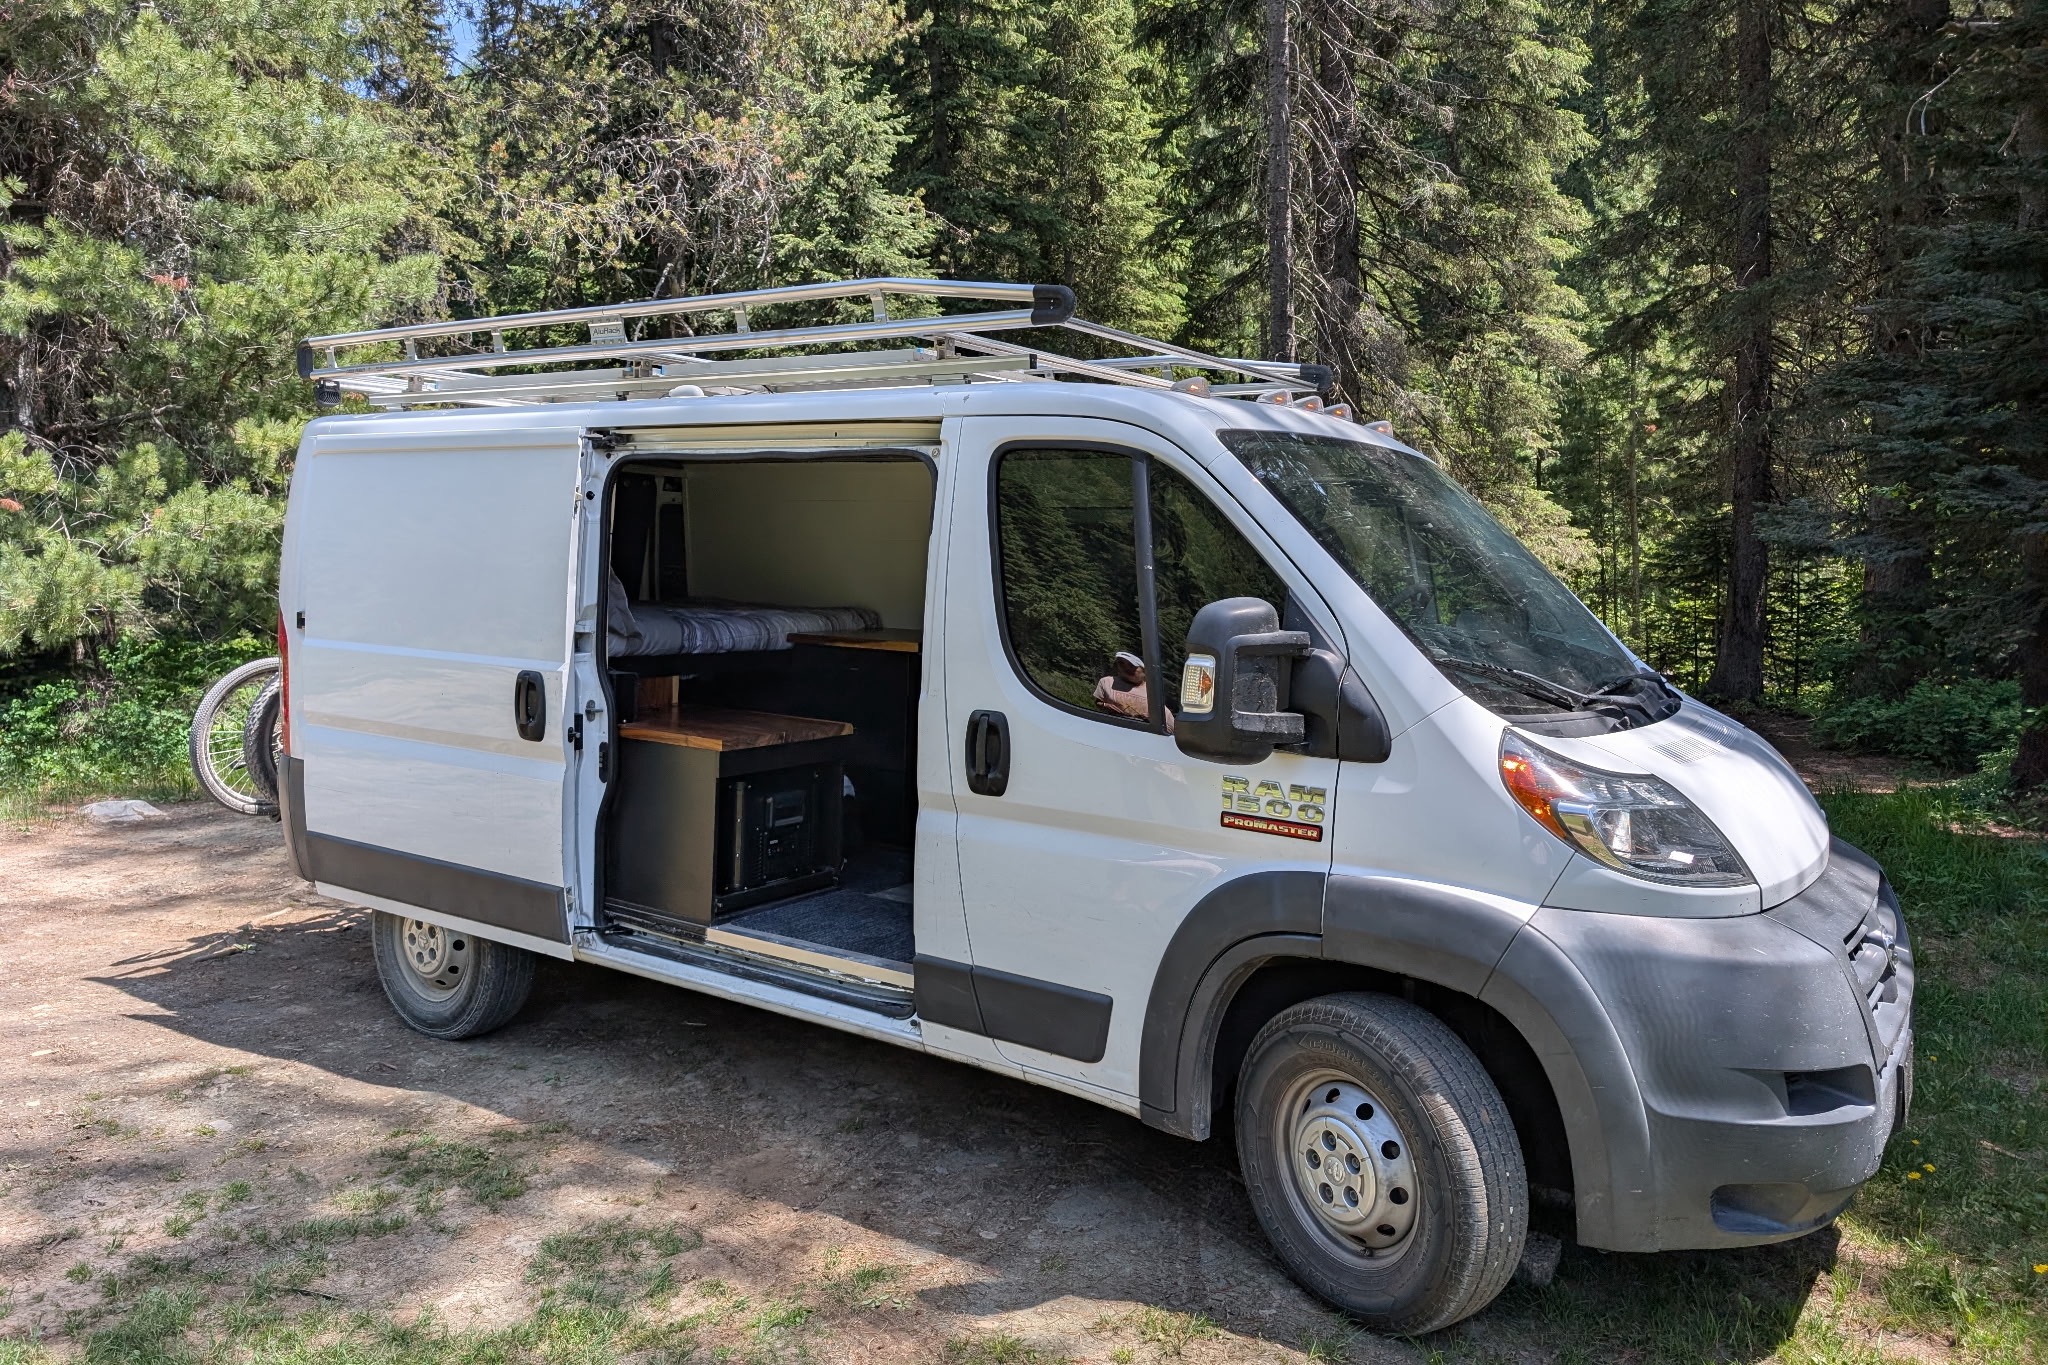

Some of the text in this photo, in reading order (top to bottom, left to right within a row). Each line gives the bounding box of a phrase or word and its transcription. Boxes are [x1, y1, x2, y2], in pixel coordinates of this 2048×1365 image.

[1222, 774, 1327, 805] RAM
[1221, 792, 1325, 823] 1500
[1223, 815, 1318, 838] PROMASTER
